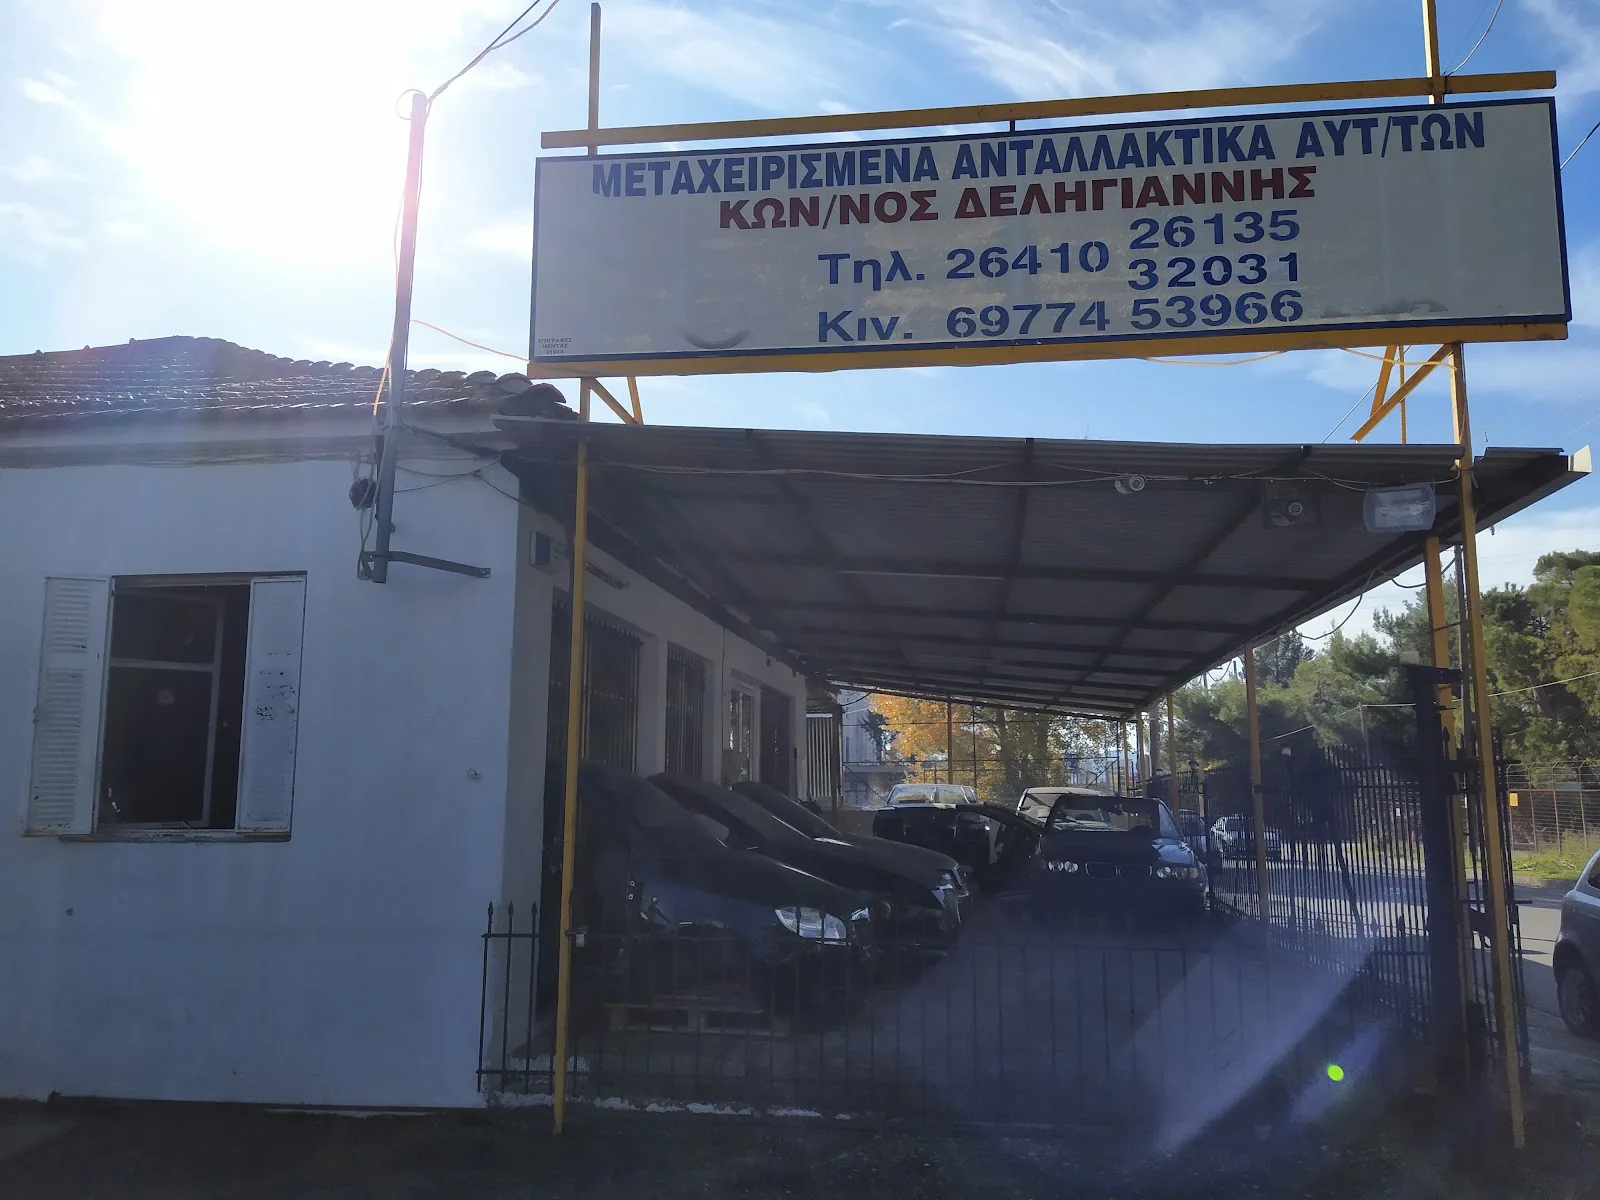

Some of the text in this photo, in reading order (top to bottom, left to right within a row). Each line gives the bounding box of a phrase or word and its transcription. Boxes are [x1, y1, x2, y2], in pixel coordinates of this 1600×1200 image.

[592, 111, 1485, 197] ΜΕΤΑΧΕΙΡΙΣΜΕΝΑ ΑΝΤΑΛΛΑΚΤΙΚΑ ΑΥΤ/ΤΩΝ
[719, 165, 1317, 230] ΚΩΝ/ΝΟΣ ΔΕΛΗΓΙΑΝΝΗΣ
[1129, 209, 1301, 250] 26135
[818, 241, 1110, 291] Τηλ. 26410
[1127, 252, 1299, 291] 32031
[818, 289, 1304, 343] Κιν. 69774 53966
